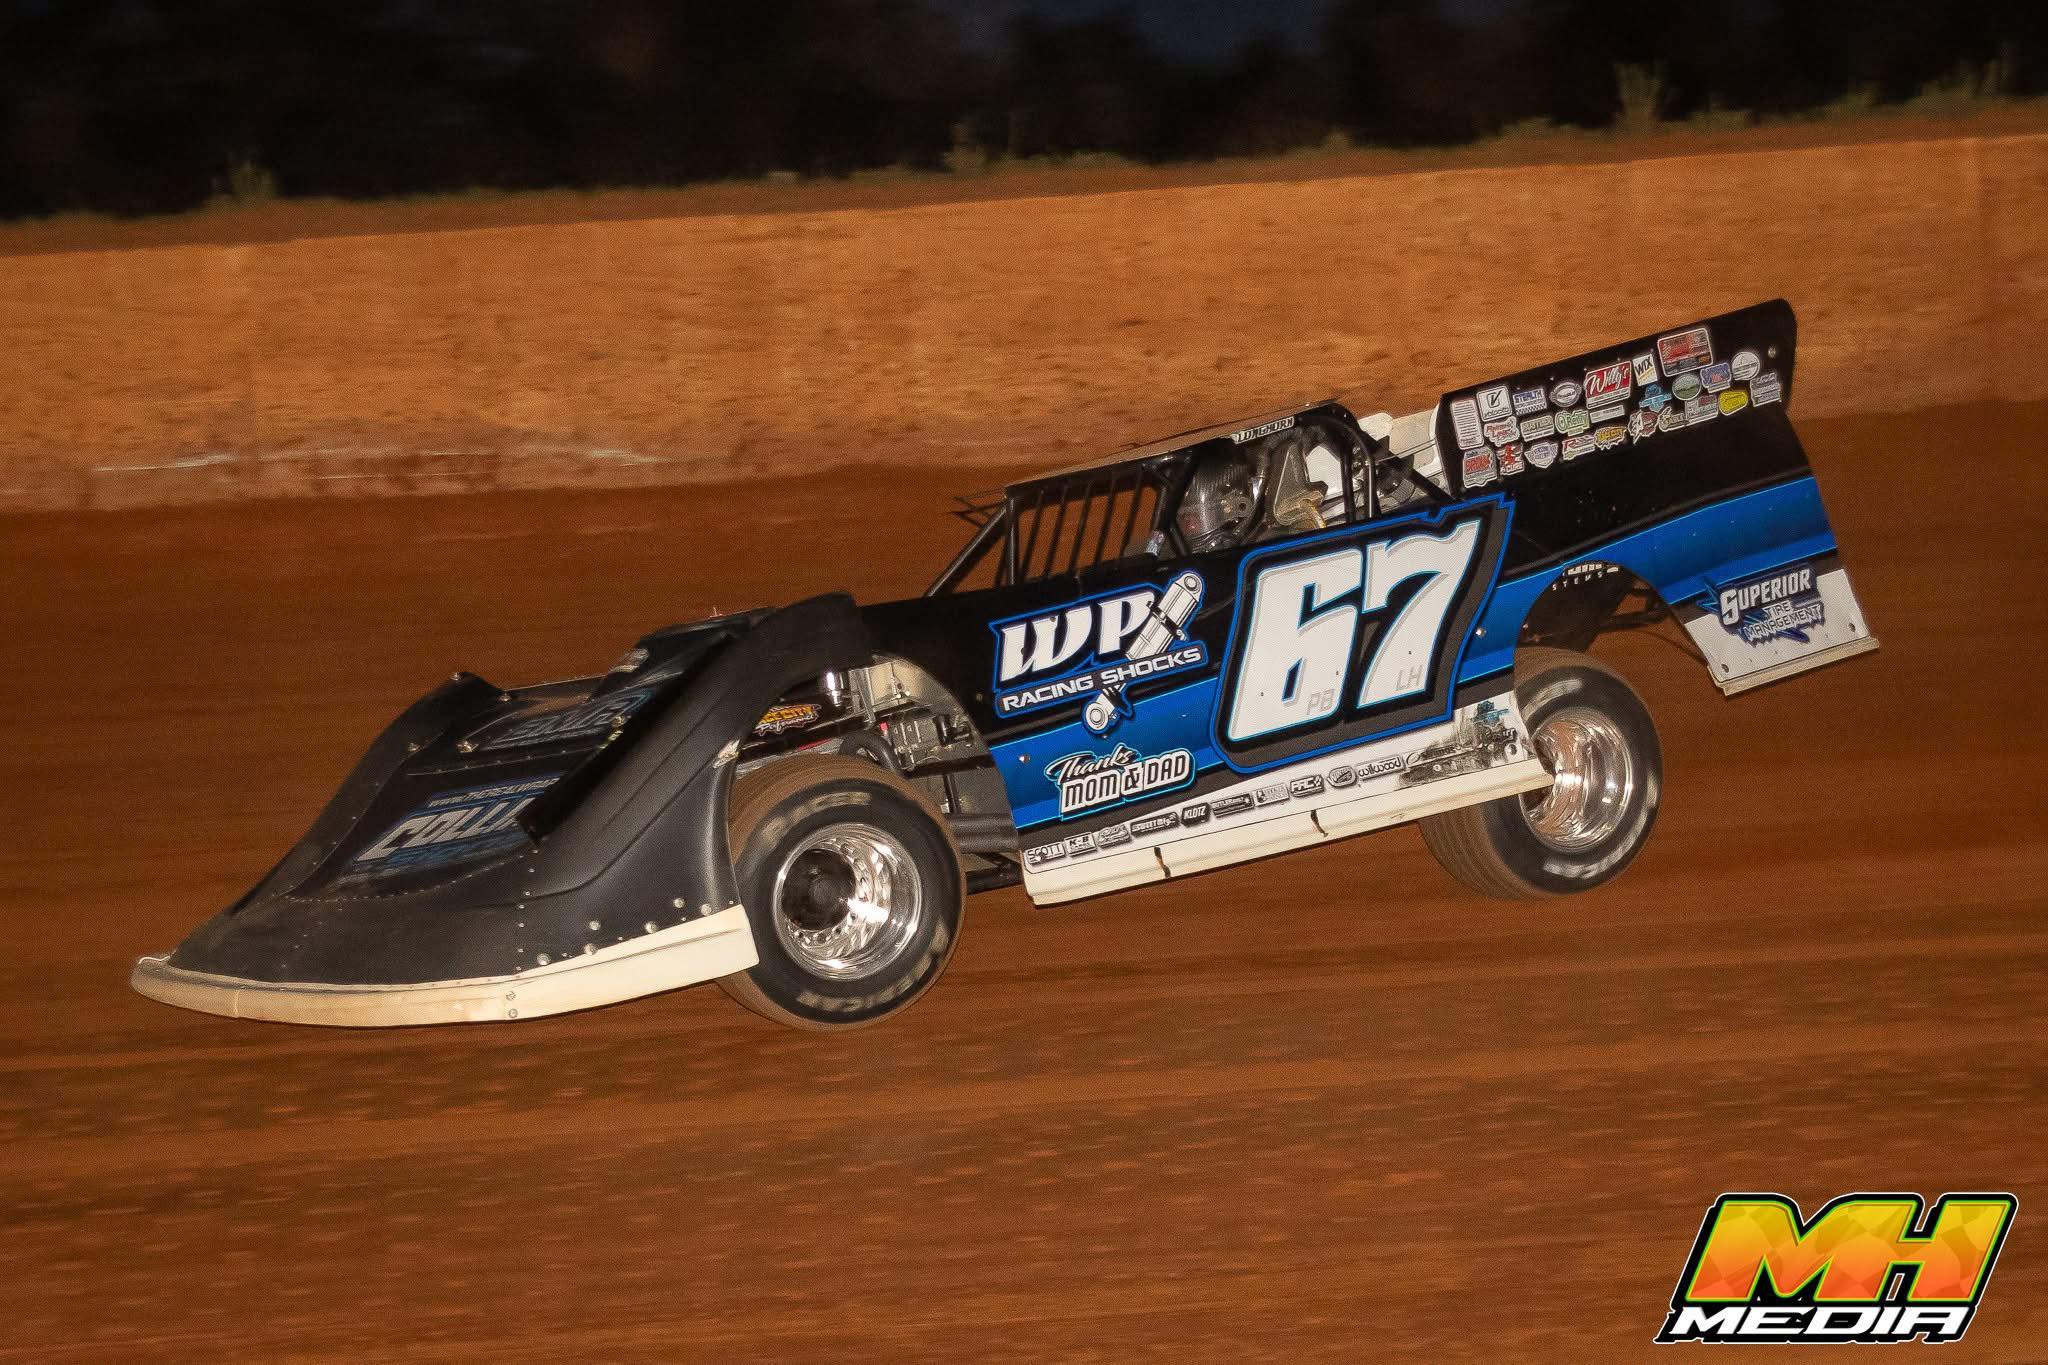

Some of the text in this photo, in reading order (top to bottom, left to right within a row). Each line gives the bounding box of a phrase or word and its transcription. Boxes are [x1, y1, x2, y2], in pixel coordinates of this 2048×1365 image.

[1635, 356, 1653, 372] WIX
[1589, 365, 1629, 395] Willy's
[1236, 416, 1295, 443] LONGHORN
[1719, 567, 1812, 626] SUPERIOR
[1765, 600, 1792, 619] TIRE
[1228, 520, 1481, 741] 67
[1743, 604, 1822, 637] MANAGEMENT
[1002, 647, 1202, 712] RACING SHOCKS
[1046, 744, 1133, 786] Thanks
[1358, 756, 1402, 778] wilwood
[1064, 754, 1187, 809] MOM & DAD
[1183, 806, 1206, 820] KLOTZ
[1027, 842, 1062, 860] SCOTT
